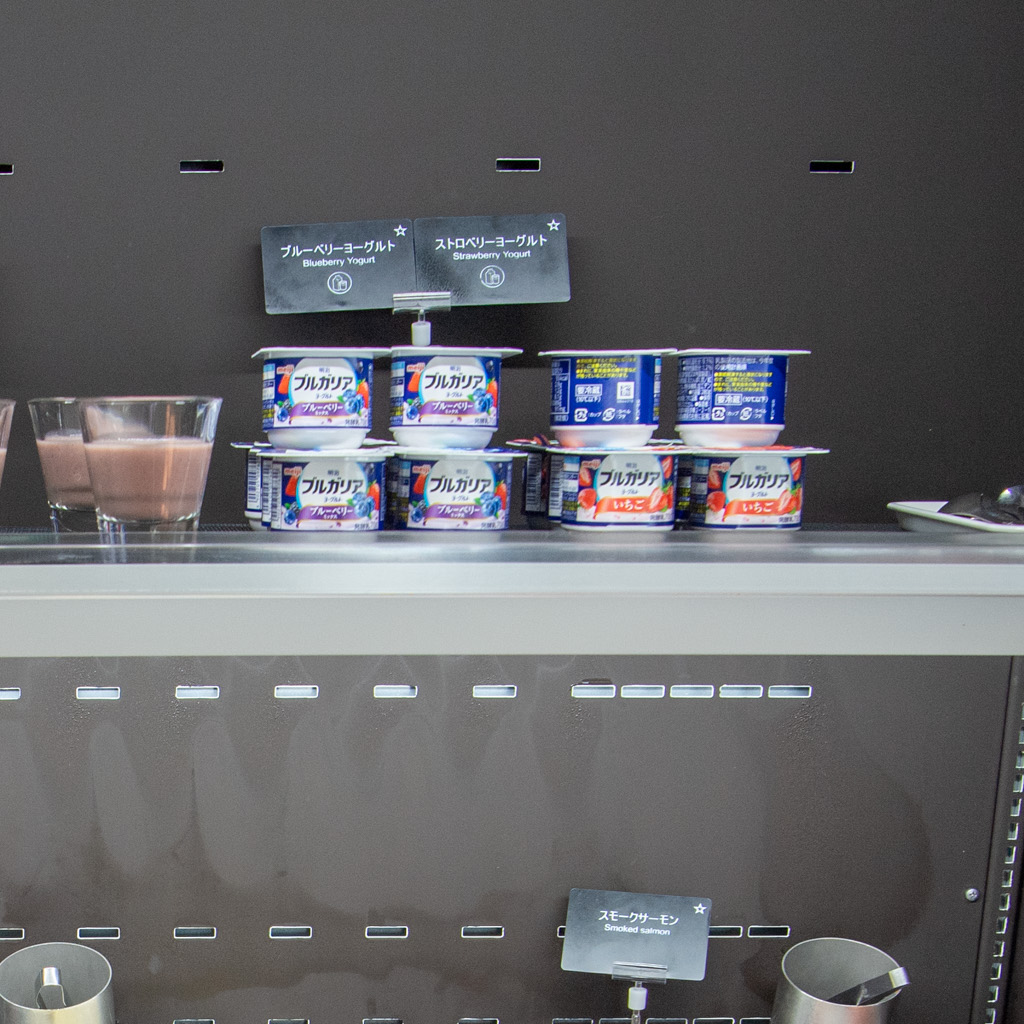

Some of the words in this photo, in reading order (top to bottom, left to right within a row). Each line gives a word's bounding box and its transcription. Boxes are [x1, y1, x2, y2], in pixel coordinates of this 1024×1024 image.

[280, 240, 396, 258] ブルーベリーヨーグルト
[435, 234, 548, 250] ストロベリーヨーグルト
[302, 258, 345, 268] Blueberry
[347, 256, 376, 266] Yogurt
[452, 251, 500, 261] Strawberry
[502, 250, 531, 260] Yogurt
[294, 374, 353, 391] ブルガリア
[424, 372, 484, 389] ブルガリア
[302, 403, 344, 413] ブルーベリー
[432, 402, 474, 411] ブルーベリー
[430, 475, 492, 493] ブルガリア
[600, 469, 661, 486] ブルガリア
[729, 471, 789, 489] ブルガリア
[302, 476, 363, 494] ブルガリア
[310, 506, 353, 516] ブルーベリー
[438, 505, 480, 514] ブルーベリー
[613, 499, 645, 511] いちご
[742, 501, 774, 513] いちご
[598, 910, 679, 926] スモークサーモン
[604, 924, 638, 934] Smoked
[640, 926, 670, 936] salmon
